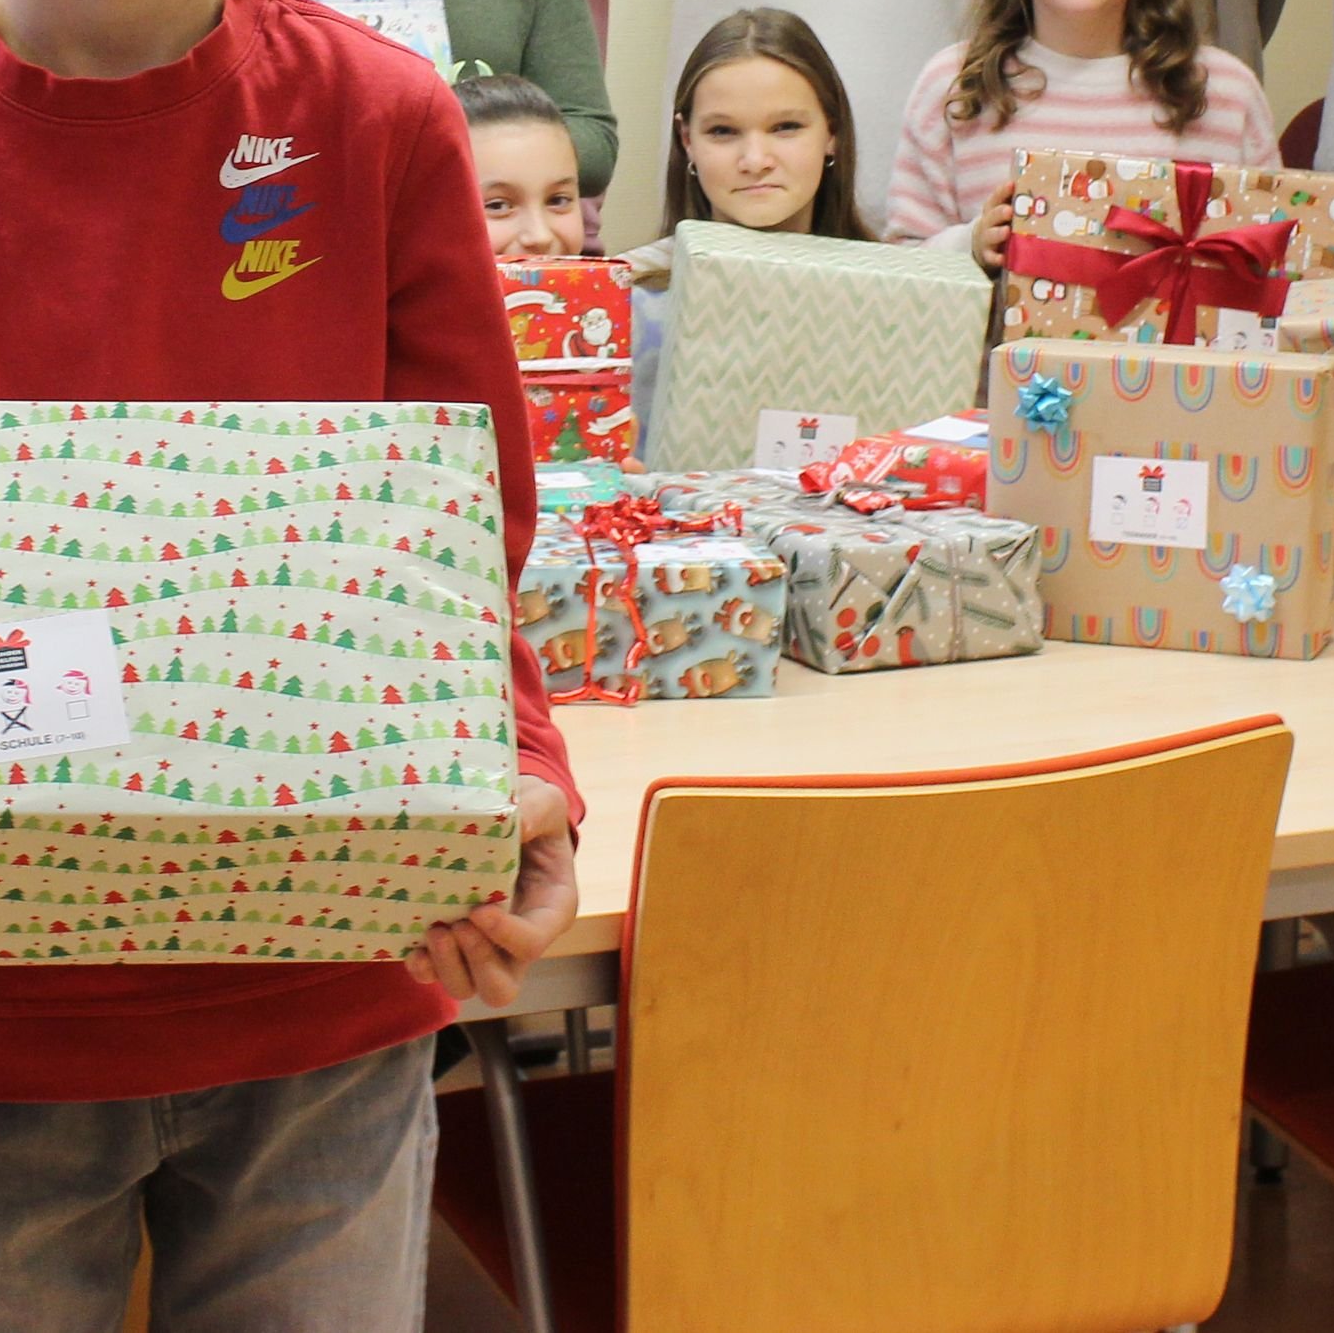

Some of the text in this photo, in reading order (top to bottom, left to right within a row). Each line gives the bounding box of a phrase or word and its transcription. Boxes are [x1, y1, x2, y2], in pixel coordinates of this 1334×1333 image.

[233, 134, 294, 164] NIKE
[234, 185, 298, 216] NIKE
[236, 240, 300, 273] NIKE
